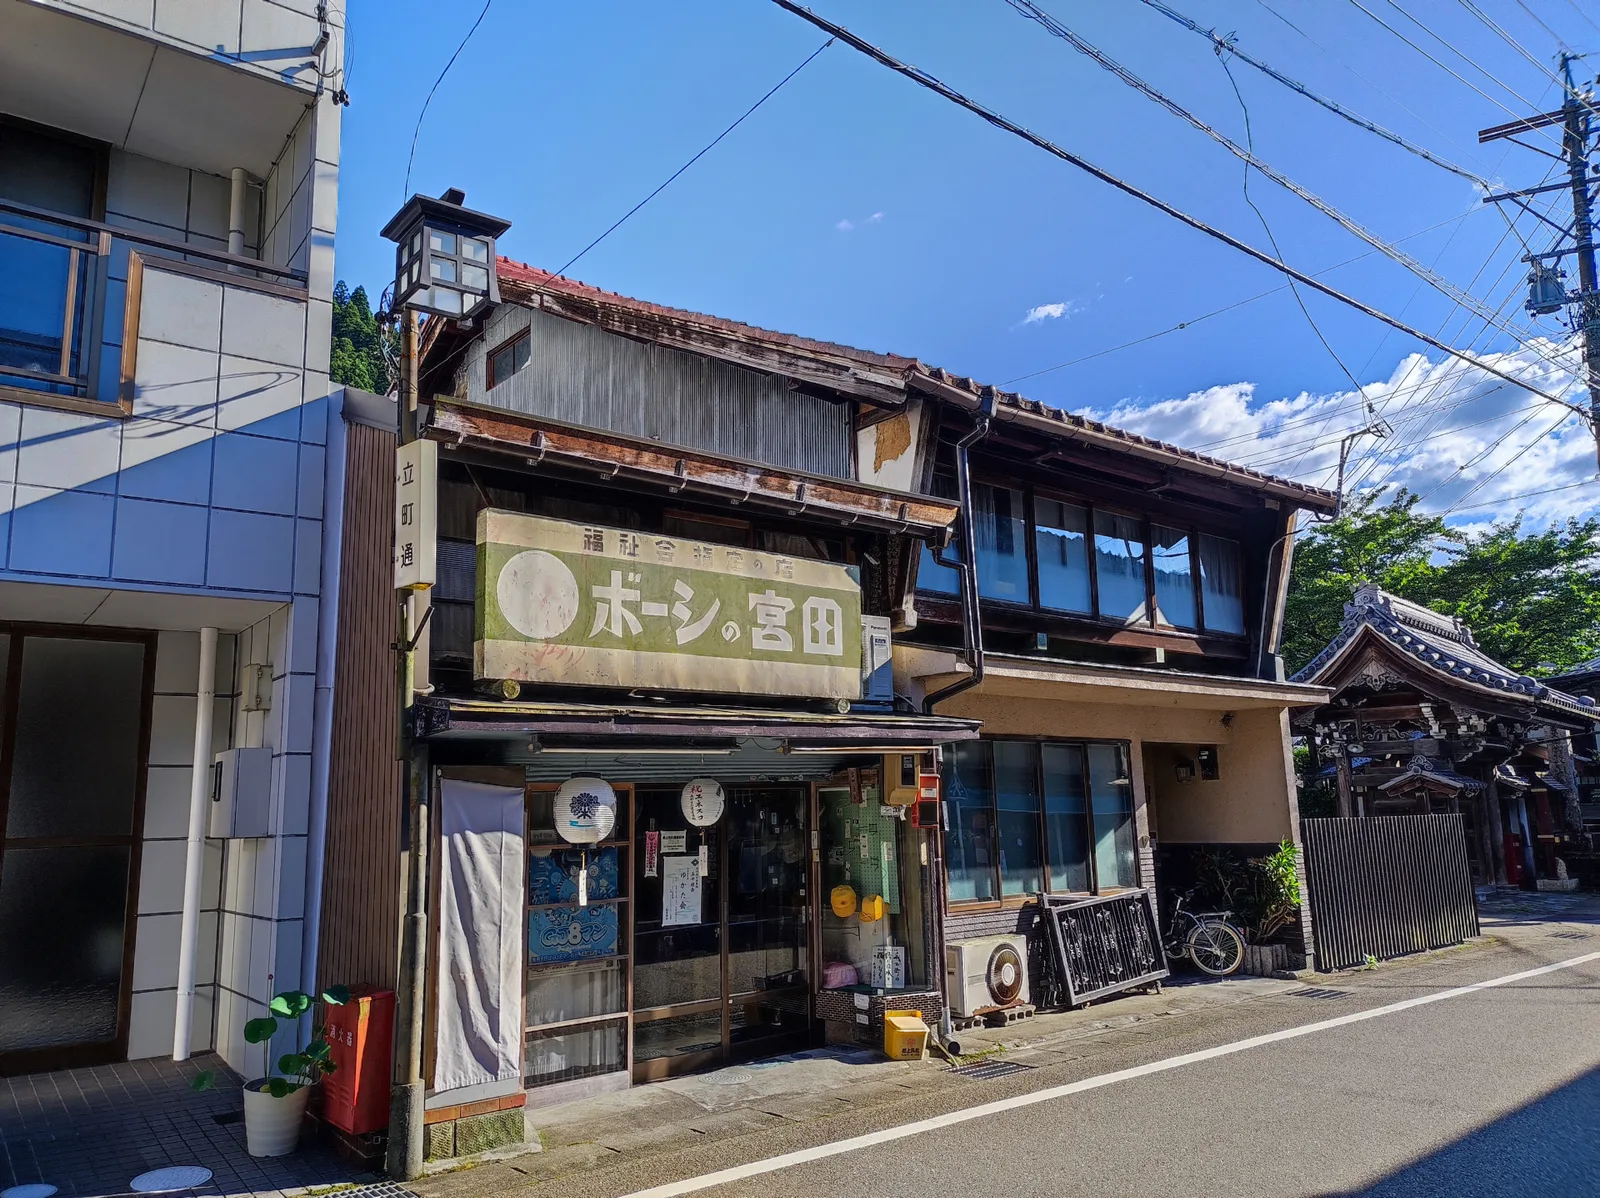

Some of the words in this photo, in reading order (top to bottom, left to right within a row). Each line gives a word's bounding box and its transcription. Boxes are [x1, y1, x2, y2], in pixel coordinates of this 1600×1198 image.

[401, 461, 414, 569] 立町通
[588, 570, 844, 657] ボーシの宮田
[330, 1024, 352, 1047] 消火器
